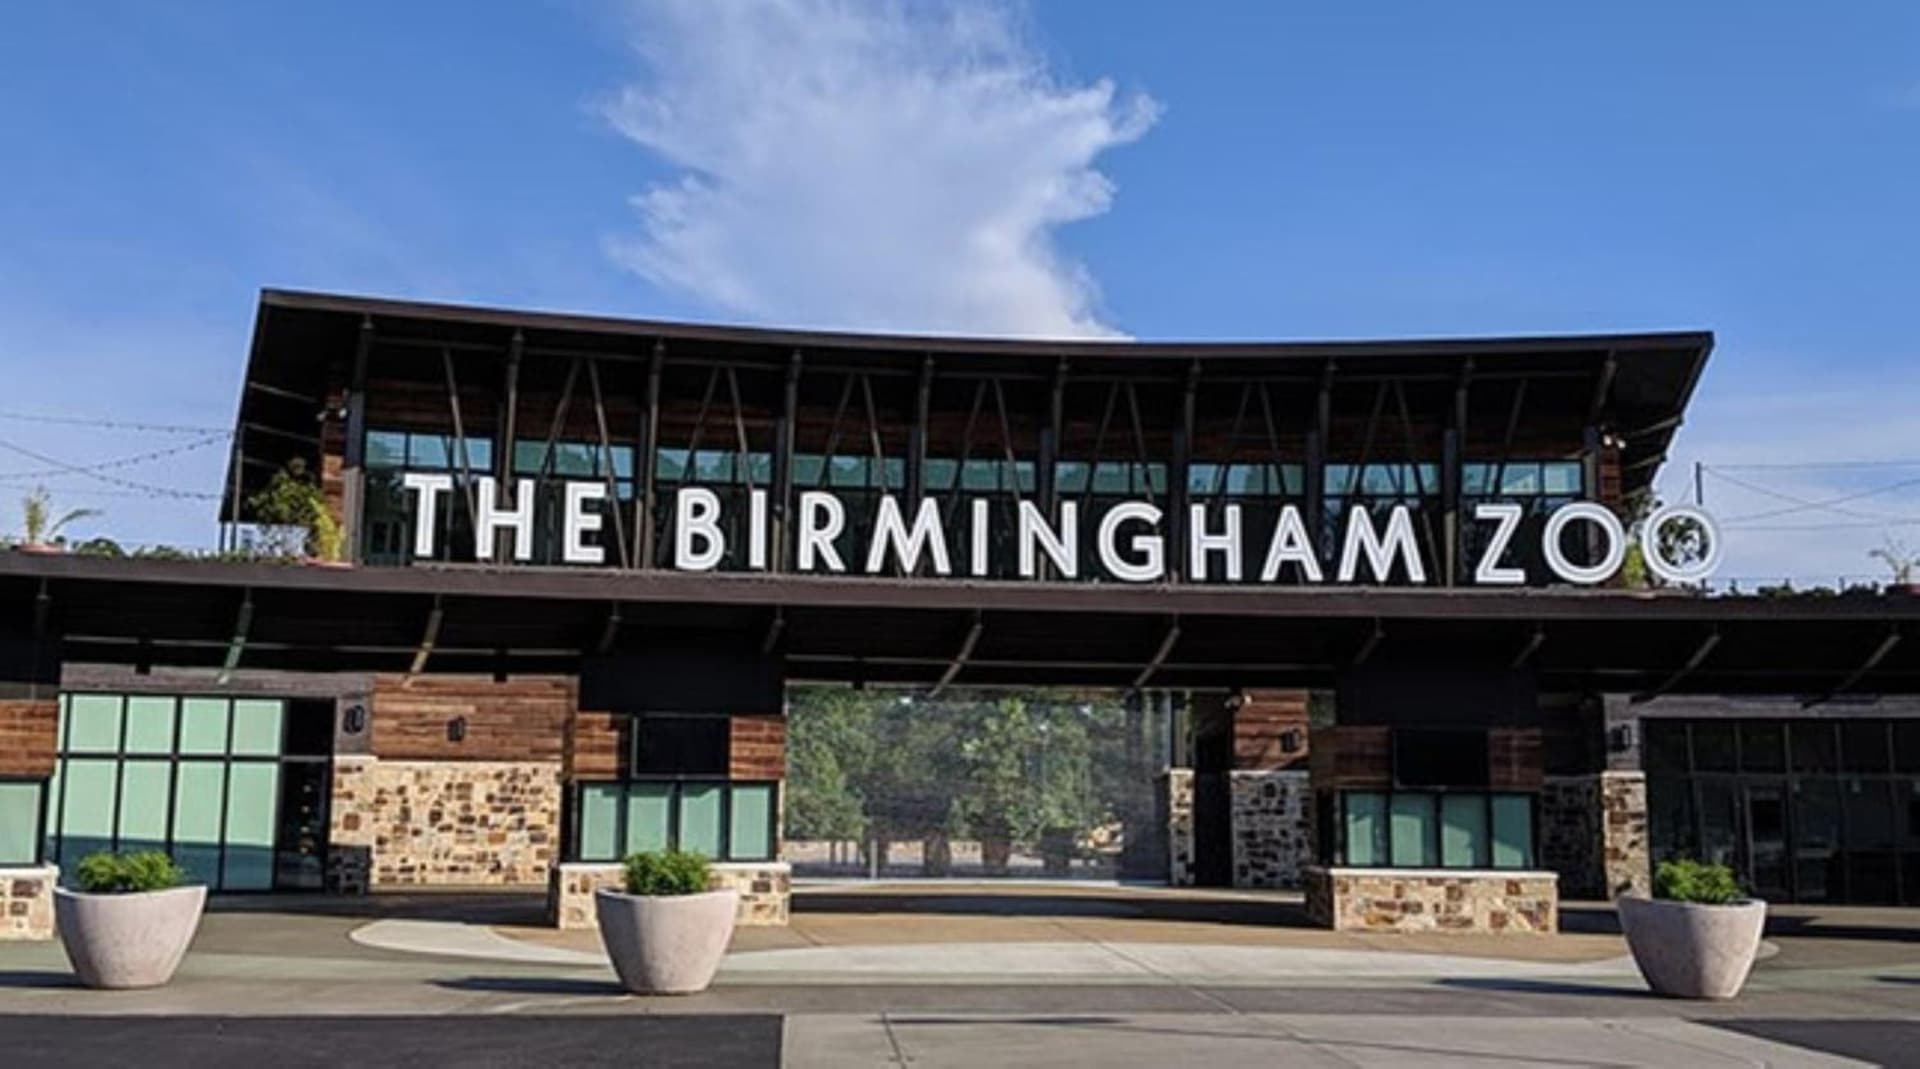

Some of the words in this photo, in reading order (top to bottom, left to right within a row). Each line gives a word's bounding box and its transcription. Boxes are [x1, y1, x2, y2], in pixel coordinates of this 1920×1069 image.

[404, 472, 607, 564] THE
[674, 487, 1426, 582] BIRMINGHAM
[1474, 501, 1722, 584] ZOO
